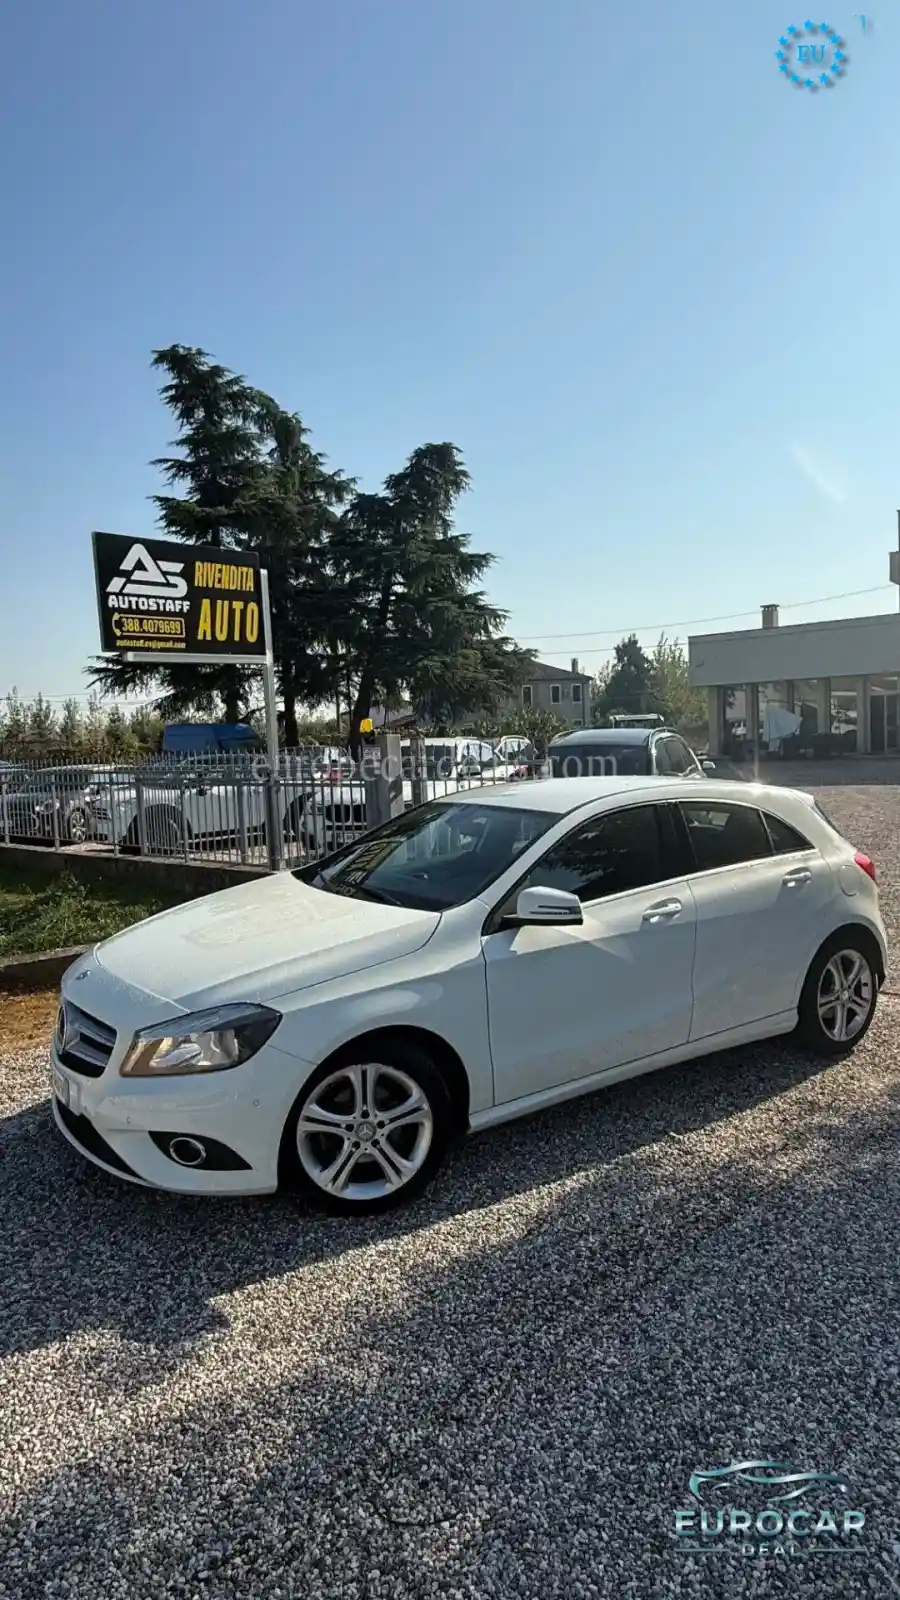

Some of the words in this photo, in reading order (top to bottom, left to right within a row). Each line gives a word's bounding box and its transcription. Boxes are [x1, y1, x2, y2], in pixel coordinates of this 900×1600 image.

[194, 560, 255, 592] RIVENDITA
[107, 594, 191, 613] AUTOSTAFF
[121, 617, 181, 634] 388.4079699
[197, 598, 260, 644] AUTO
